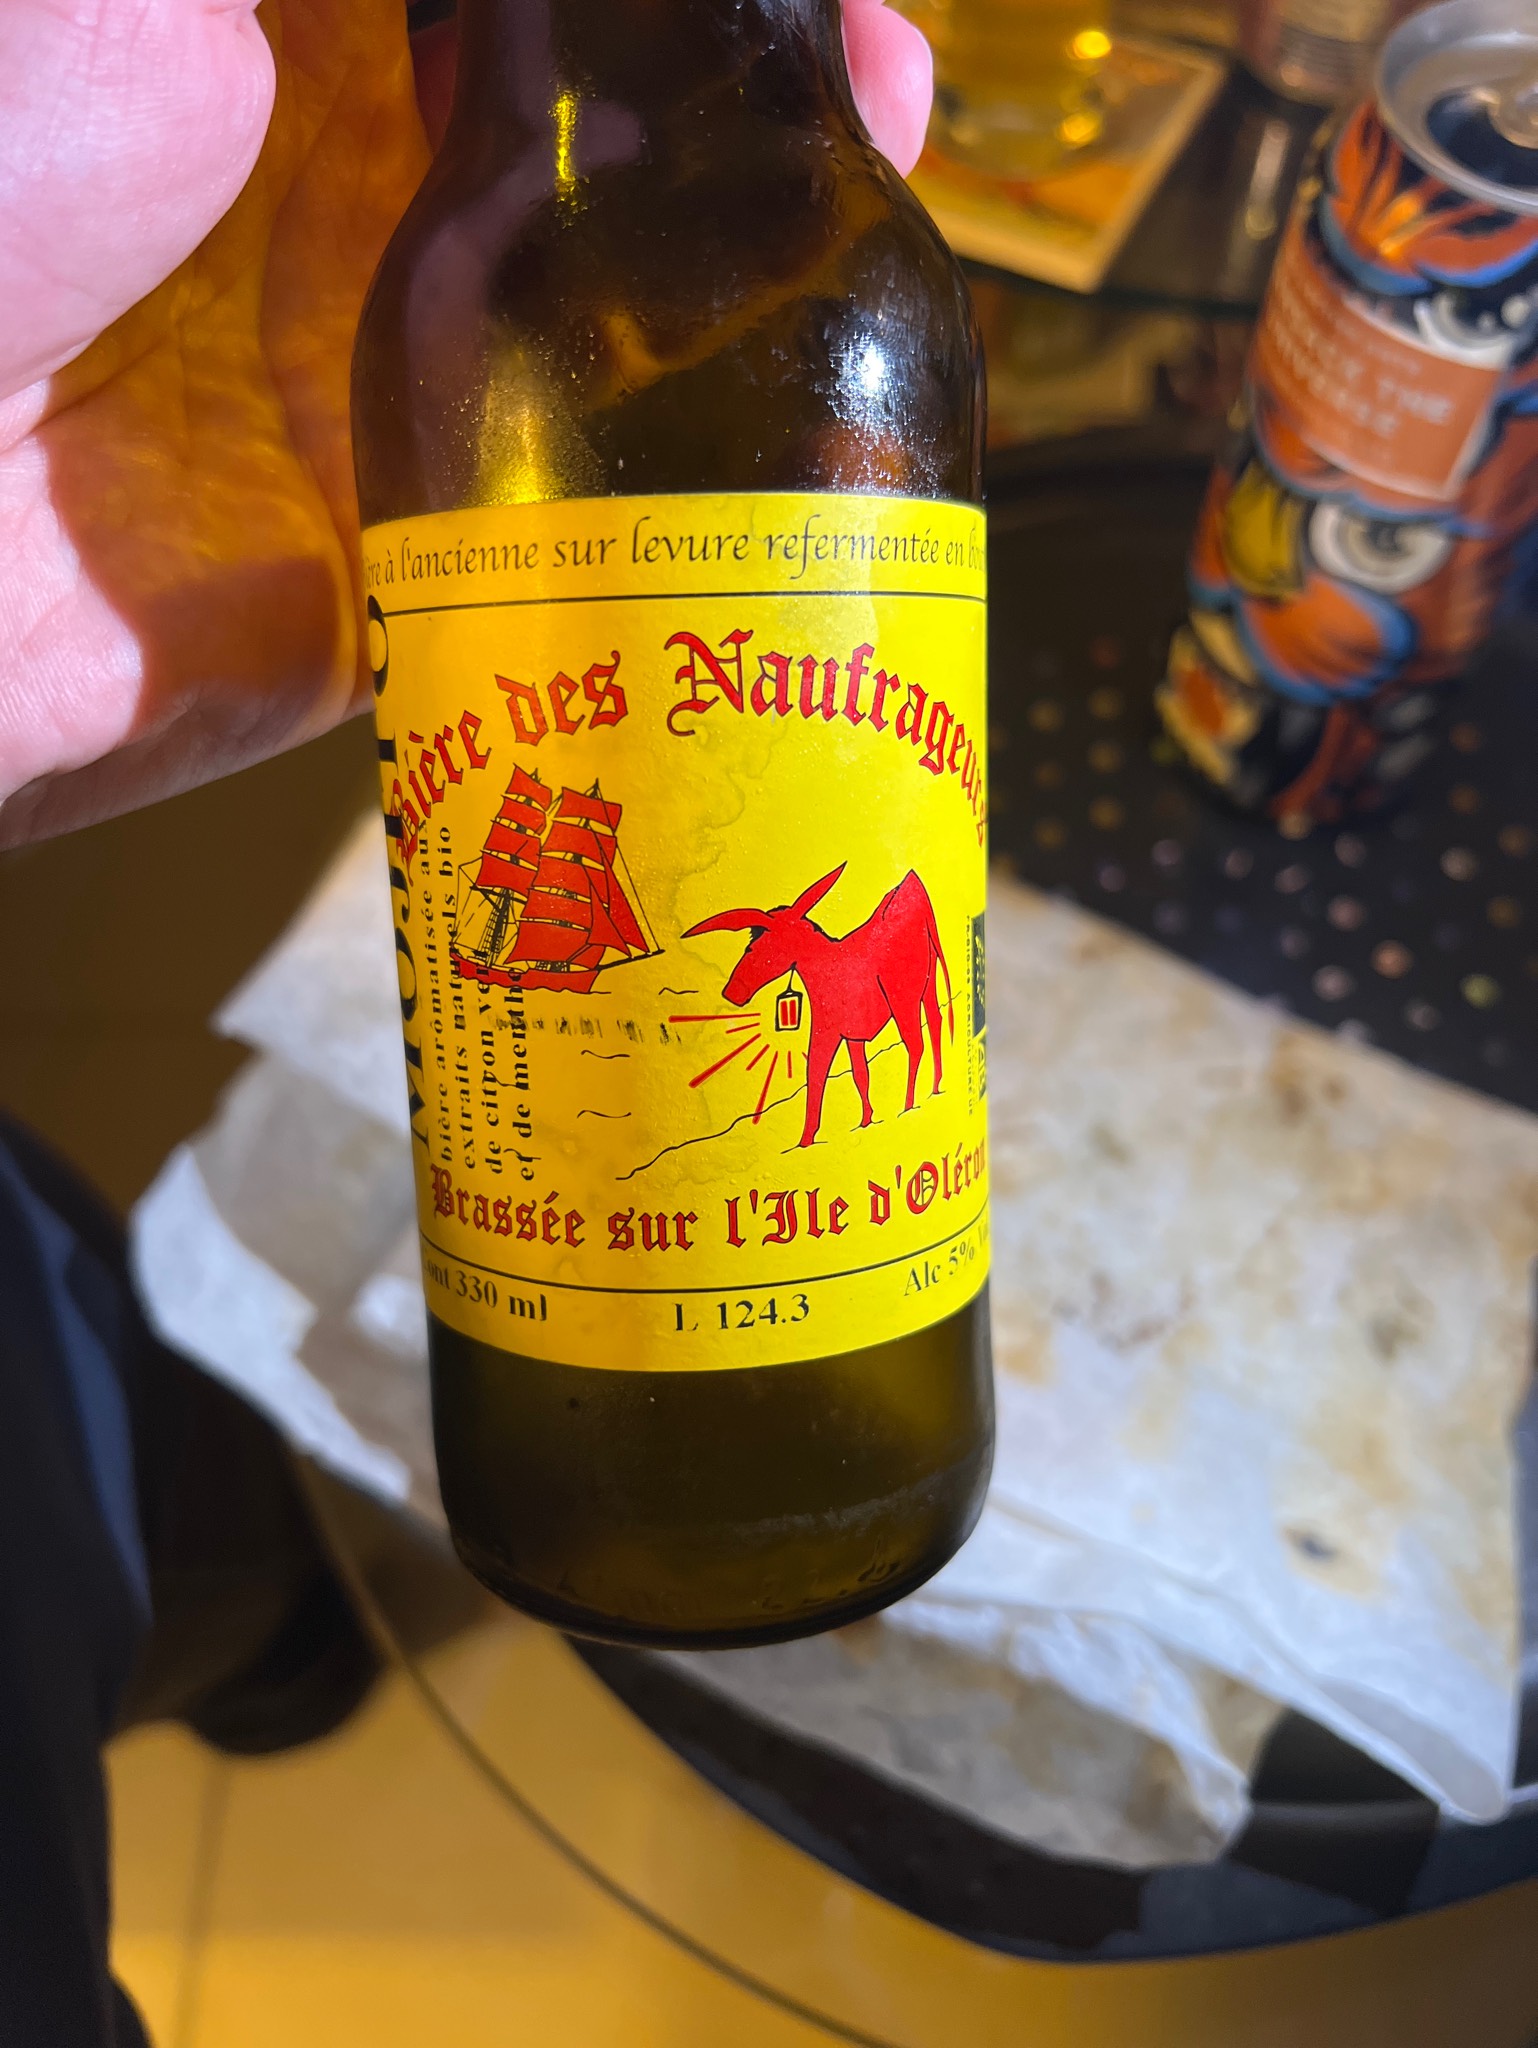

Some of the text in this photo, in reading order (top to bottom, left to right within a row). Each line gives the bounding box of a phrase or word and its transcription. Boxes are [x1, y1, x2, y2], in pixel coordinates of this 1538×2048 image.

[385, 548, 394, 585] à
[401, 536, 540, 582] l'ancienne
[552, 537, 617, 568] sur
[631, 515, 750, 564] levure
[766, 513, 939, 580] refermentée
[946, 540, 965, 567] en
[494, 650, 628, 747] des
[437, 826, 454, 877] bio
[418, 819, 453, 1163] bière arômatisée aux
[455, 1045, 476, 1169] extraits
[512, 1103, 533, 1138] de
[485, 1140, 503, 1174] de
[430, 1163, 586, 1248] Brassée
[608, 1207, 699, 1251] sur
[456, 1270, 498, 1308] 330
[508, 1294, 548, 1322] ml
[904, 1261, 941, 1297] Alc
[674, 1293, 810, 1332] L 124.3
